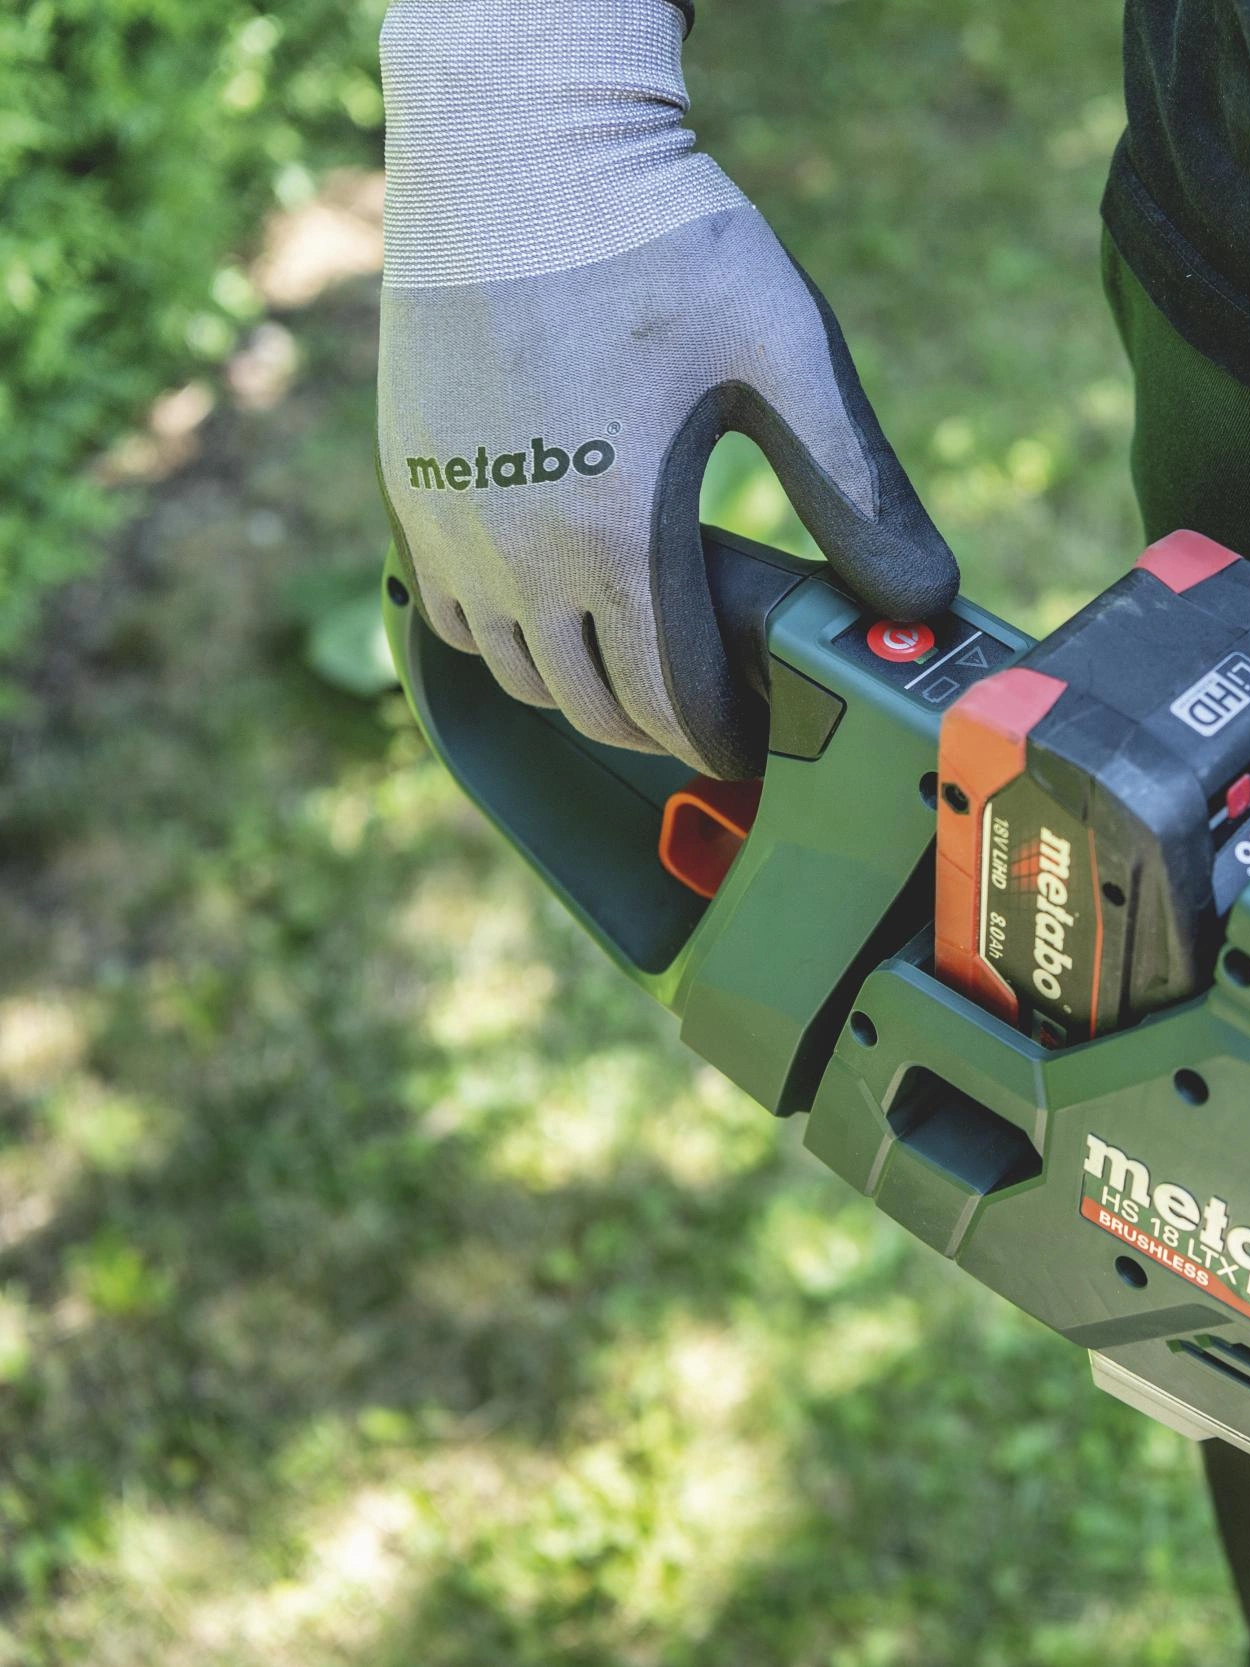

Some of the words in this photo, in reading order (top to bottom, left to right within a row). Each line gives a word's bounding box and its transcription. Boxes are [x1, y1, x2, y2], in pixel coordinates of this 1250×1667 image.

[991, 847, 1009, 890] LiHD
[992, 816, 1009, 848] 18V
[1032, 826, 1074, 1000] metabo
[1099, 1209, 1209, 1287] BRUSHLESS
[1101, 1185, 1139, 1223] HS
[1150, 1217, 1180, 1248] 18
[1187, 1237, 1240, 1286] LTX
